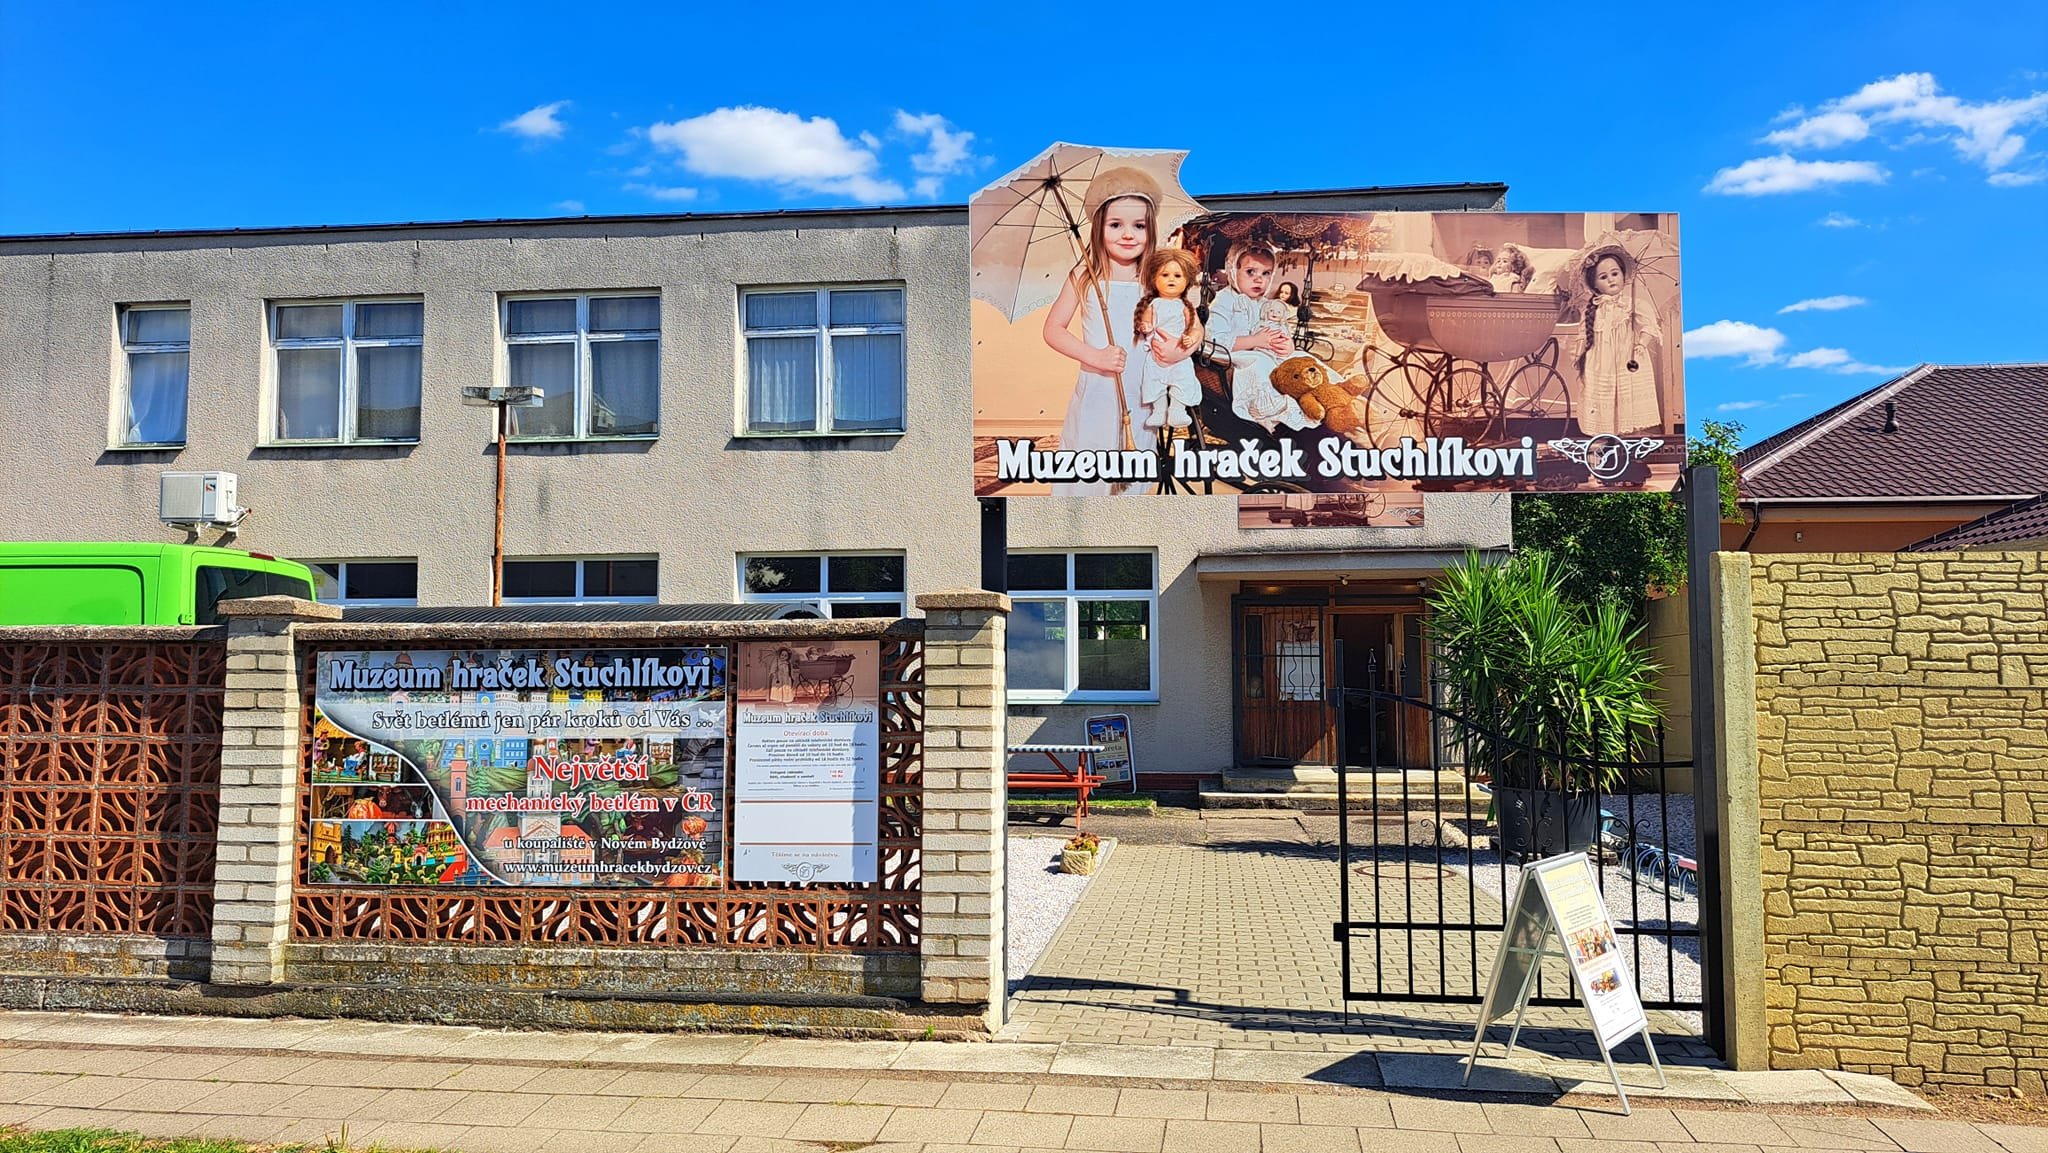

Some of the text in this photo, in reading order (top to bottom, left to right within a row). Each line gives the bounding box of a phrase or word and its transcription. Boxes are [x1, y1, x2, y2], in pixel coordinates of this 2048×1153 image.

[997, 436, 1535, 480] Muzeum hraček Stuchlíkovi
[331, 657, 712, 690] Muzeum hraček Stuchlíkovi
[372, 710, 411, 729] Svět
[415, 710, 490, 729] betlémů
[494, 712, 525, 734] jen
[528, 709, 561, 734] pár
[565, 709, 621, 729] kroků
[626, 709, 651, 728] od
[655, 709, 691, 728] Vás
[743, 709, 873, 724] Muzeum hraček Stuchlíkovi
[534, 754, 649, 788] Největší
[466, 786, 716, 817] mechanický betlém v ČR
[504, 836, 707, 854] u koupaliště v Novém Bydžově
[504, 861, 712, 879] www.muzeumhracekbydzov.cz
